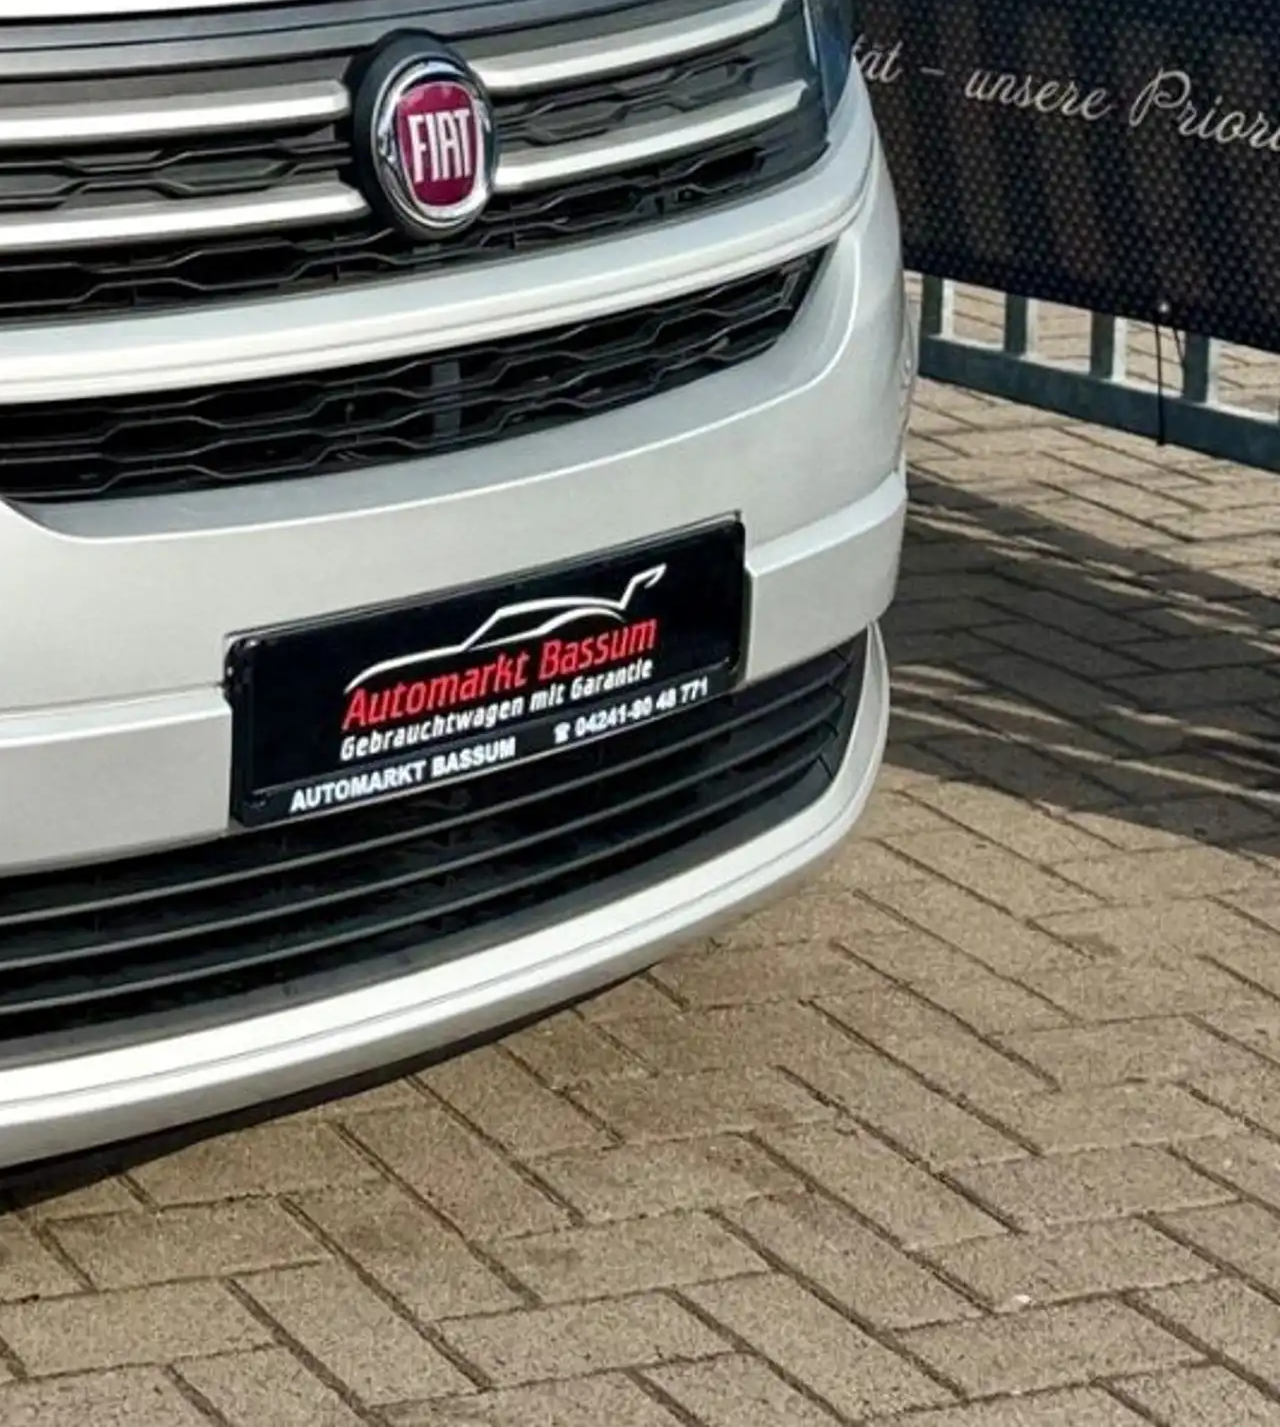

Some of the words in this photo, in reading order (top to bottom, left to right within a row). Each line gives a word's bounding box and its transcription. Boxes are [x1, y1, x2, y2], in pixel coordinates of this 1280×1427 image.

[963, 68, 1114, 123] unsere
[407, 107, 471, 184] FIAT
[340, 695, 525, 762] Gebrauchtwagen
[529, 682, 567, 713] mit
[570, 657, 653, 701] Garantie
[342, 650, 530, 731] Automarkt
[538, 618, 658, 682] Bassum
[289, 759, 427, 813] AUTOMARKT
[431, 735, 517, 776] BASSUM
